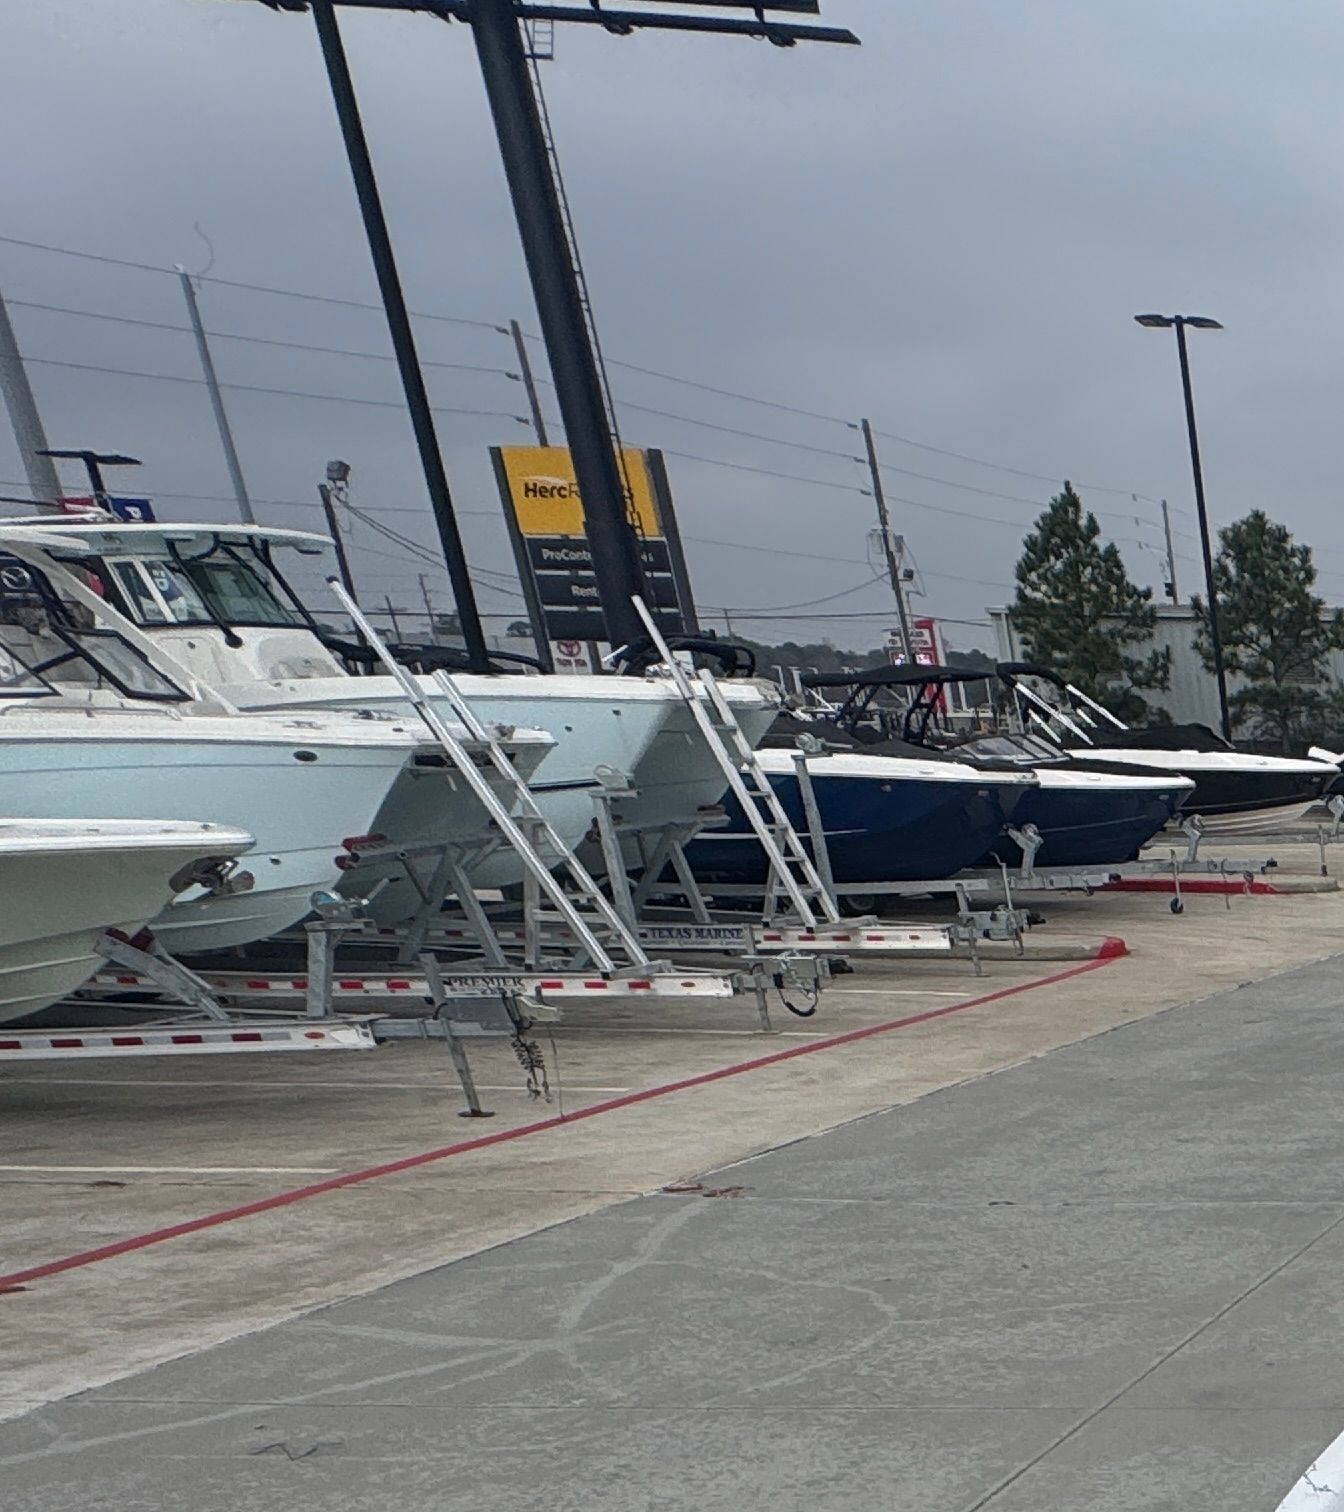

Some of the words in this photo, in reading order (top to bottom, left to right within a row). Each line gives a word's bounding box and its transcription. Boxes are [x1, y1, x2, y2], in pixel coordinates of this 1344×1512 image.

[524, 482, 581, 499] HercR
[651, 927, 692, 939] TEXAS
[694, 928, 744, 940] MARINE
[448, 976, 525, 988] PREMIER
